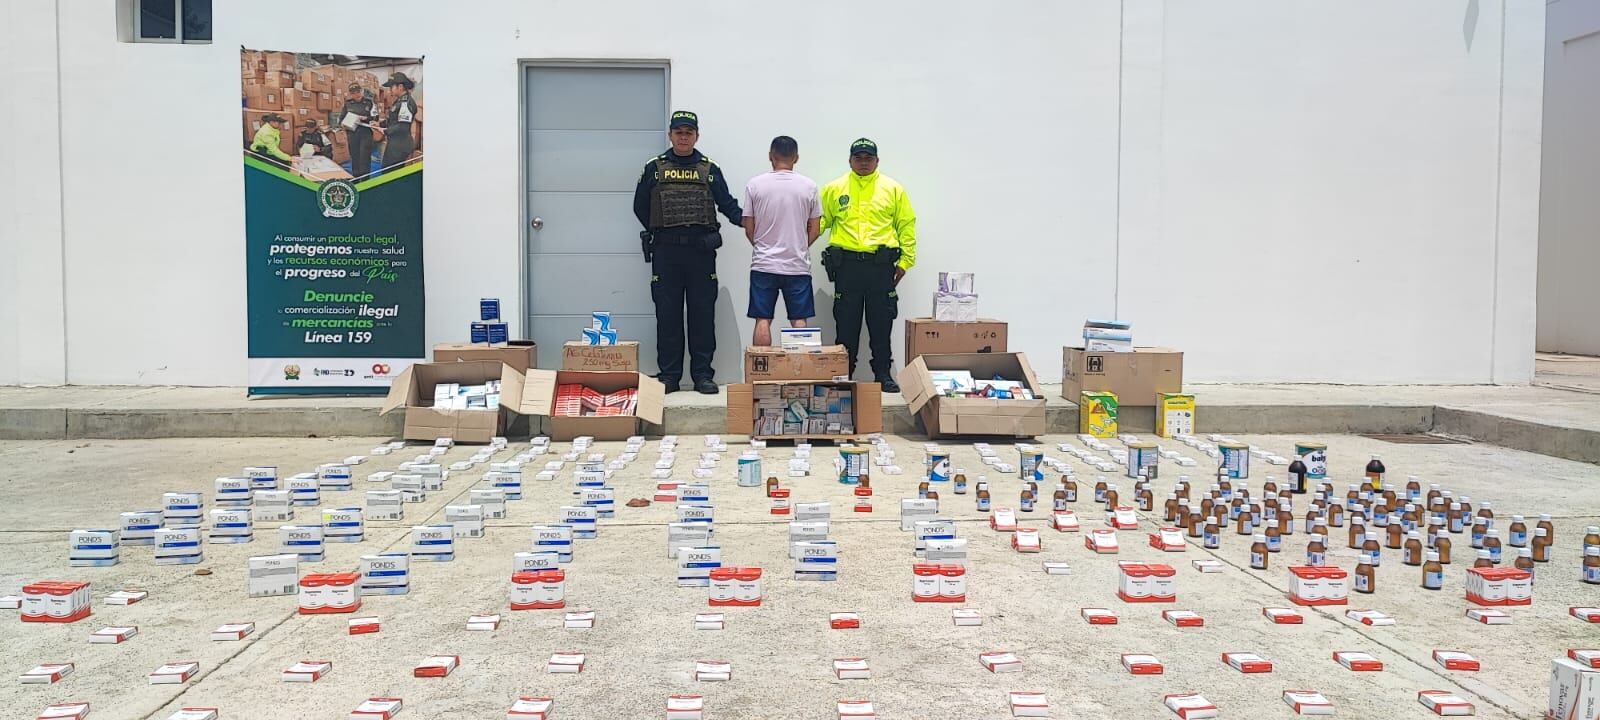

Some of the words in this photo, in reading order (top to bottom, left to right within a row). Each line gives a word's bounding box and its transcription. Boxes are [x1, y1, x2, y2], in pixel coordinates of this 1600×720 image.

[664, 169, 699, 180] POLICIA
[328, 234, 370, 244] producto
[270, 243, 352, 256] protegemos
[382, 246, 405, 255] salud
[330, 256, 389, 266] económicos
[284, 268, 346, 280] progreso
[304, 290, 374, 303] Denuncie
[285, 306, 355, 314] comercialización
[359, 304, 398, 319] ilegal
[292, 317, 374, 328] mercancías
[305, 331, 342, 343] Línea
[348, 332, 372, 343] 159
